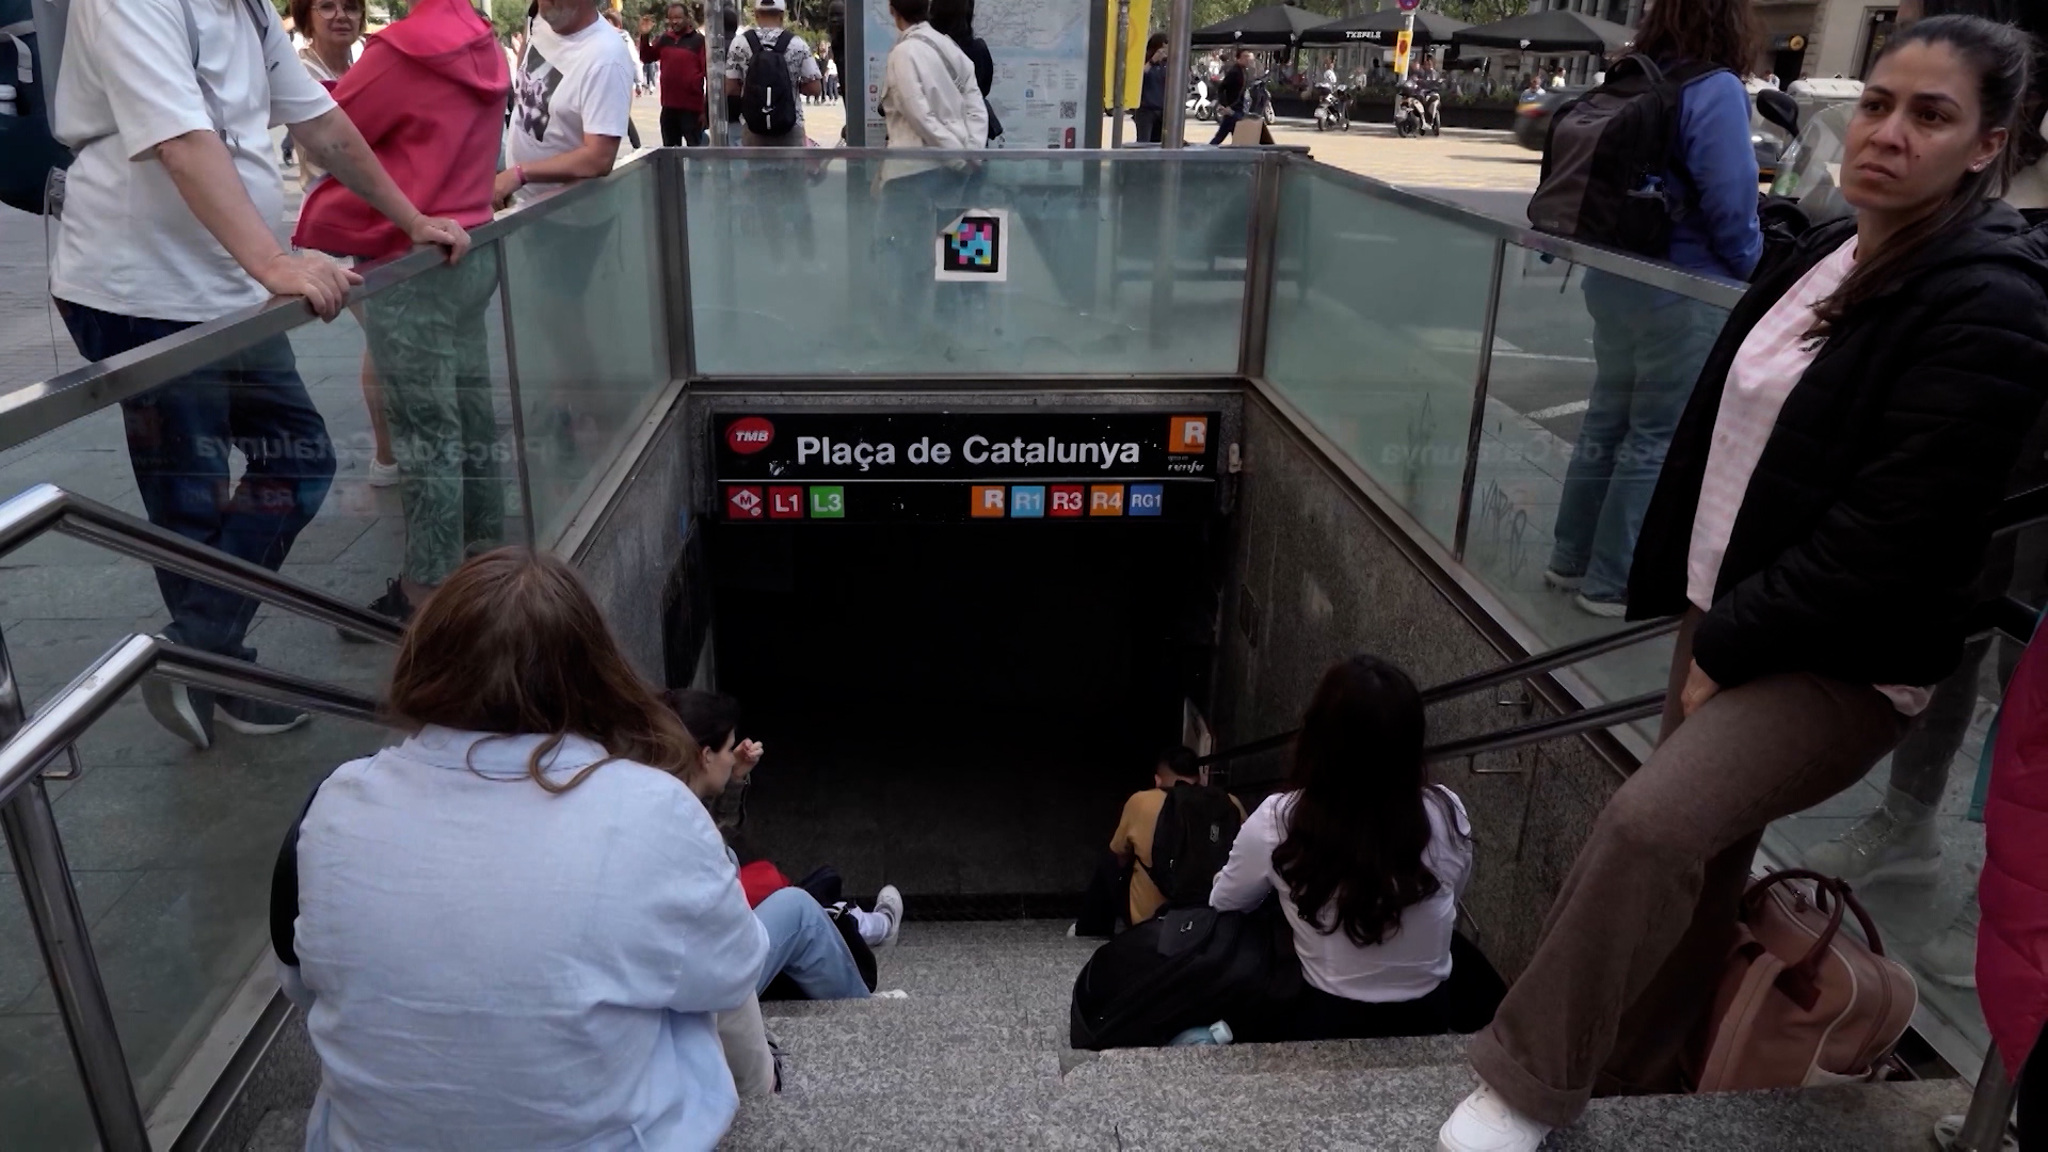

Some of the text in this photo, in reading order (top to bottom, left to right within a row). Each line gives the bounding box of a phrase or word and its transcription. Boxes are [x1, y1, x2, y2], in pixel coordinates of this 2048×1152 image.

[735, 430, 769, 442] TMB
[1184, 421, 1206, 444] R
[796, 435, 1140, 472] Plaça de Catalunya
[1167, 460, 1205, 474] renfe
[774, 493, 799, 512] L1
[813, 493, 842, 512] L3
[984, 489, 1004, 509] R
[1015, 492, 1041, 510] R1
[1052, 491, 1083, 511] R3
[1091, 491, 1122, 510] R4
[1131, 493, 1162, 509] RG1
